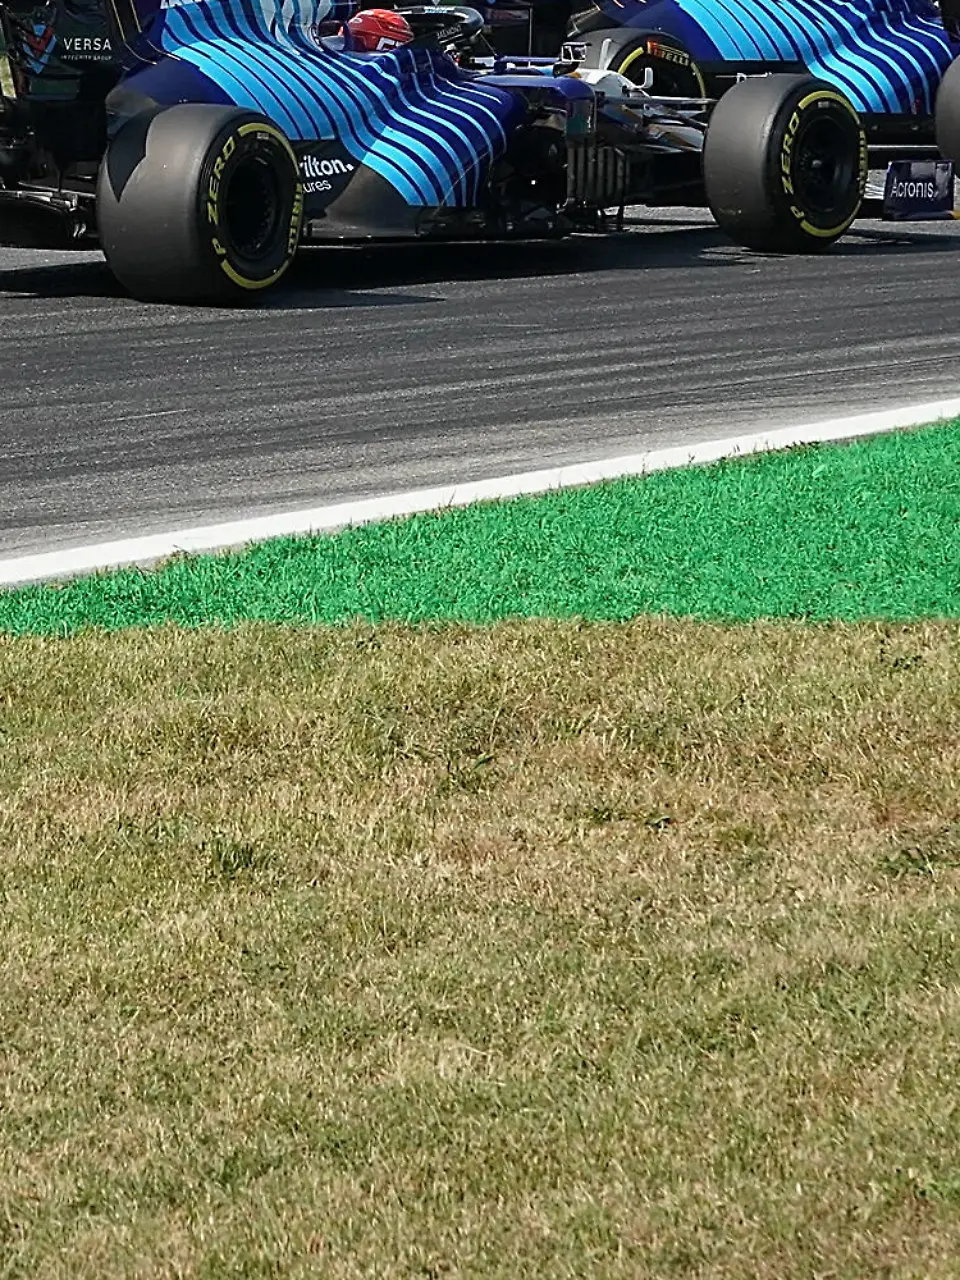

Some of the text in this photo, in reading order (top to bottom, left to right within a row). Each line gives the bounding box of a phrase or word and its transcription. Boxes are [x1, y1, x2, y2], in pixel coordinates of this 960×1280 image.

[63, 37, 112, 51] VERSA
[781, 111, 800, 195] ZERO
[207, 136, 236, 225] ZERO
[890, 177, 935, 199] Acronis
